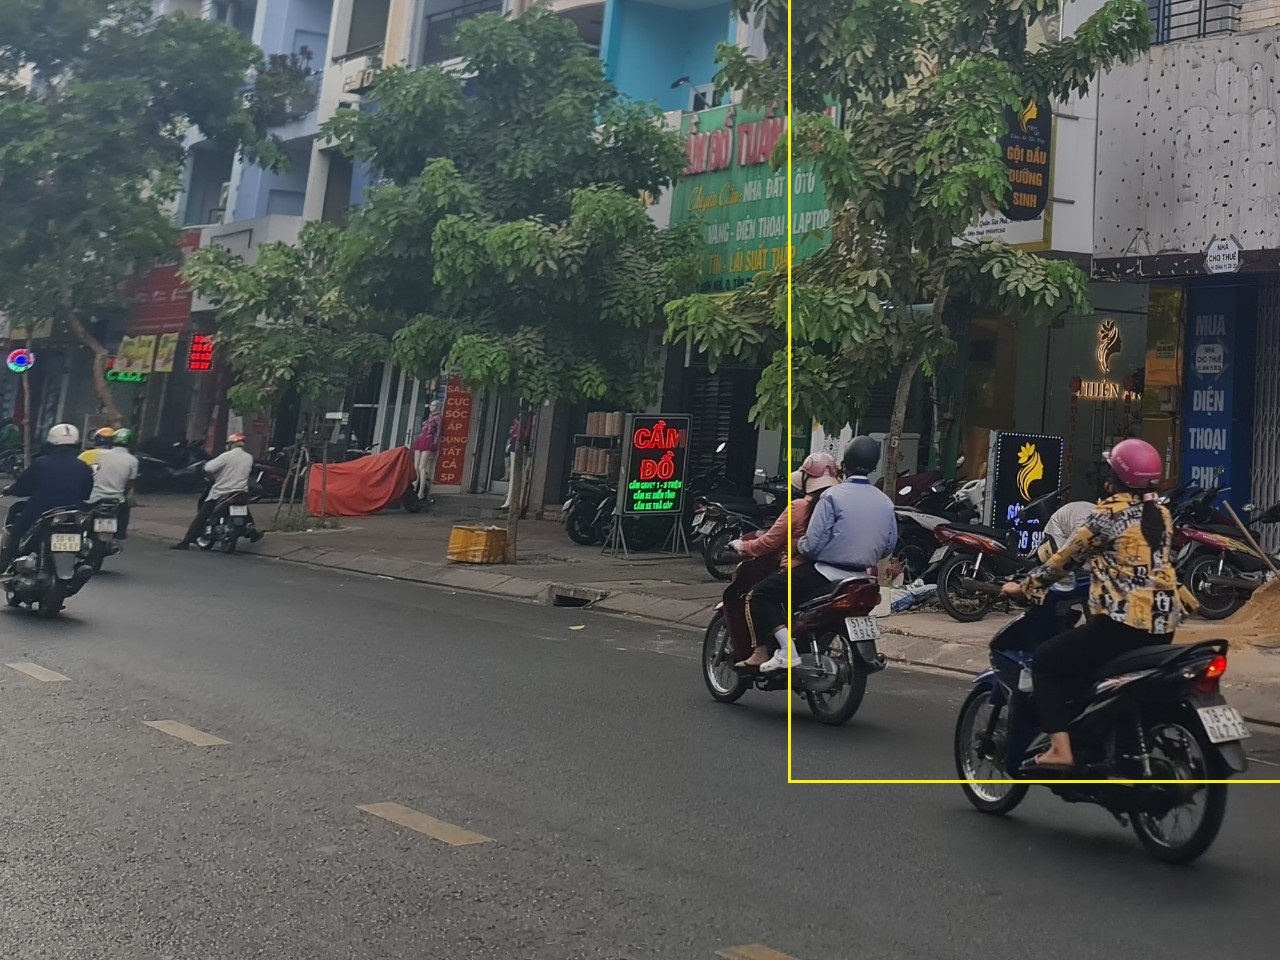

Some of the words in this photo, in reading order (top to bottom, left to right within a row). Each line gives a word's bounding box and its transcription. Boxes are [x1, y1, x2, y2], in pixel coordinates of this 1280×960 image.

[683, 114, 710, 176] ẦM
[1007, 146, 1024, 163] GỘI
[1026, 146, 1047, 165] ĐẦU
[743, 174, 762, 199] NHÀ
[765, 168, 785, 199] ĐẤT
[1008, 168, 1043, 187] DƯỠNG
[1013, 193, 1037, 208] SINH
[708, 218, 730, 244] VÀNG
[735, 215, 756, 243] ĐIỆN
[758, 215, 785, 240] THOẠI
[792, 208, 830, 235] LAPTOP
[745, 241, 769, 271] SUẤT
[1208, 254, 1221, 263] CHO
[1195, 315, 1226, 336] MUA
[447, 396, 470, 407] CỰC
[1192, 386, 1225, 416] ĐIỆN
[445, 407, 468, 418] SỐC
[447, 421, 463, 431] ÁP
[442, 445, 462, 456] TẤT
[1189, 428, 1227, 455] THOẠI
[640, 451, 675, 480] ĐỒ
[440, 473, 455, 481] SP
